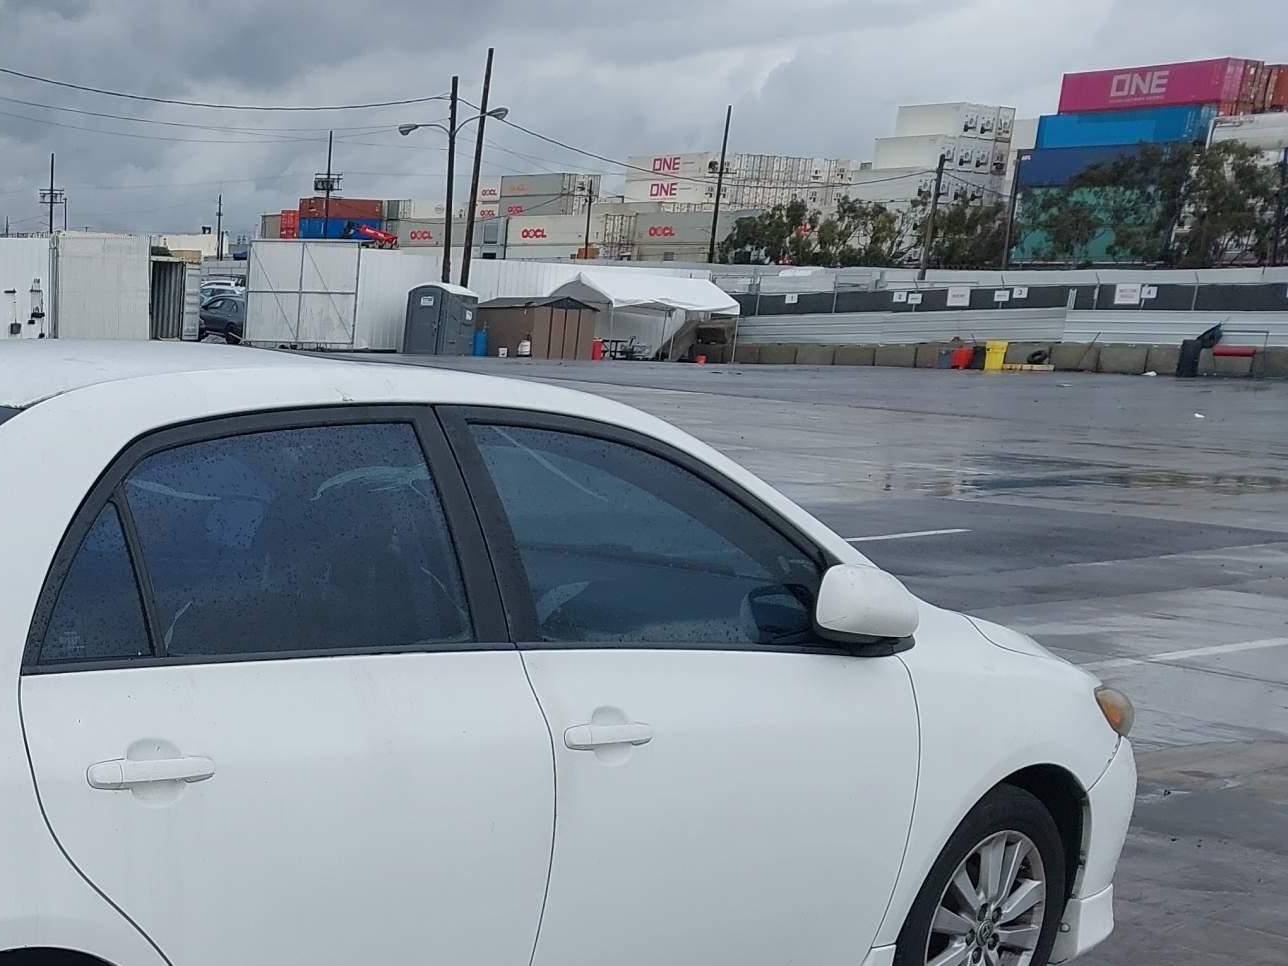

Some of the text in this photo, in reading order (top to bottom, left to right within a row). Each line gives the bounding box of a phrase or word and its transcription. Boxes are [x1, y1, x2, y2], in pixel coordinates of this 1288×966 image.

[1110, 70, 1170, 97] ONE
[652, 157, 681, 171] ONE
[649, 183, 678, 197] ONE
[410, 231, 433, 240] OOCL
[521, 228, 547, 239] OOCL
[648, 226, 675, 237] OOCL
